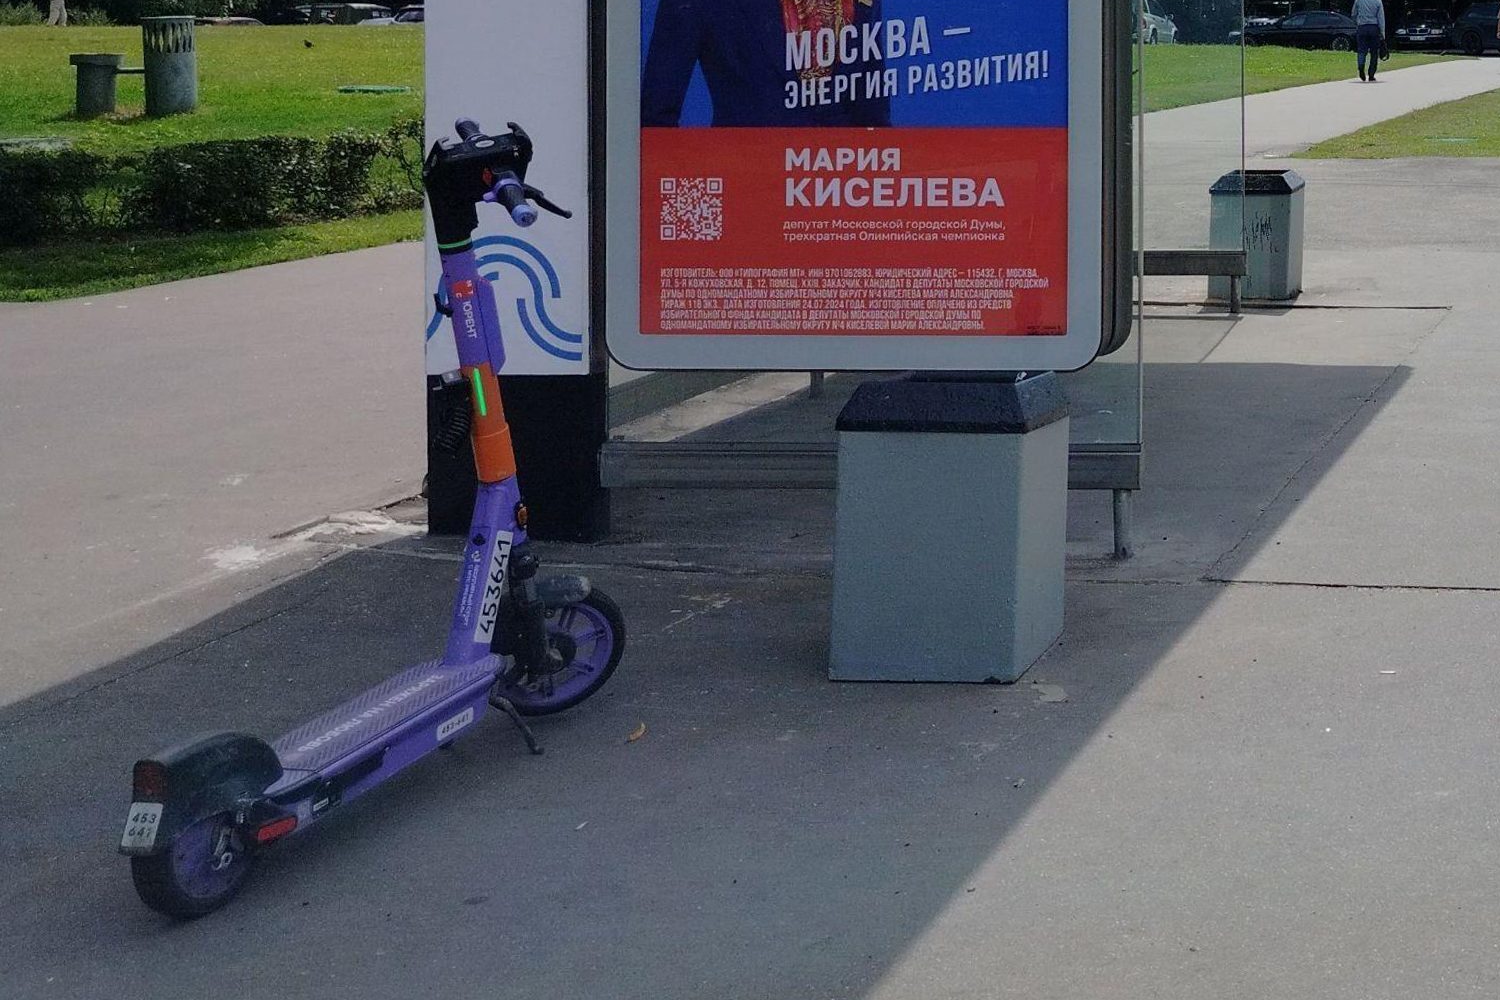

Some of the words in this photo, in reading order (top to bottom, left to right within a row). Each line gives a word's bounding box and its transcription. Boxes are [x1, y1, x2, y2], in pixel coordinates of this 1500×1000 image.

[785, 15, 931, 71] МОСКВА
[784, 67, 898, 110] ЭНЕРГИЯ
[907, 50, 1049, 95] РАЗВИТИЯ!
[784, 147, 901, 172] МАРИЯ
[784, 177, 1006, 207] КИСЕЛЕВА
[783, 220, 830, 231] депутат
[831, 218, 903, 229] Московской
[906, 218, 968, 230] городской
[969, 219, 1006, 231] Думы,
[783, 231, 856, 243] трехкратная
[859, 230, 938, 241] Олимпийская
[941, 232, 1005, 241] чемпионка
[864, 279, 904, 288] КАНДИДАТ
[912, 279, 953, 288] ДЕПУТАТЫ
[1005, 278, 1049, 288] ГОРОДСКОЙ
[462, 300, 477, 339] ЮРЕНТ
[479, 539, 511, 634] 453641
[132, 812, 158, 825] 453
